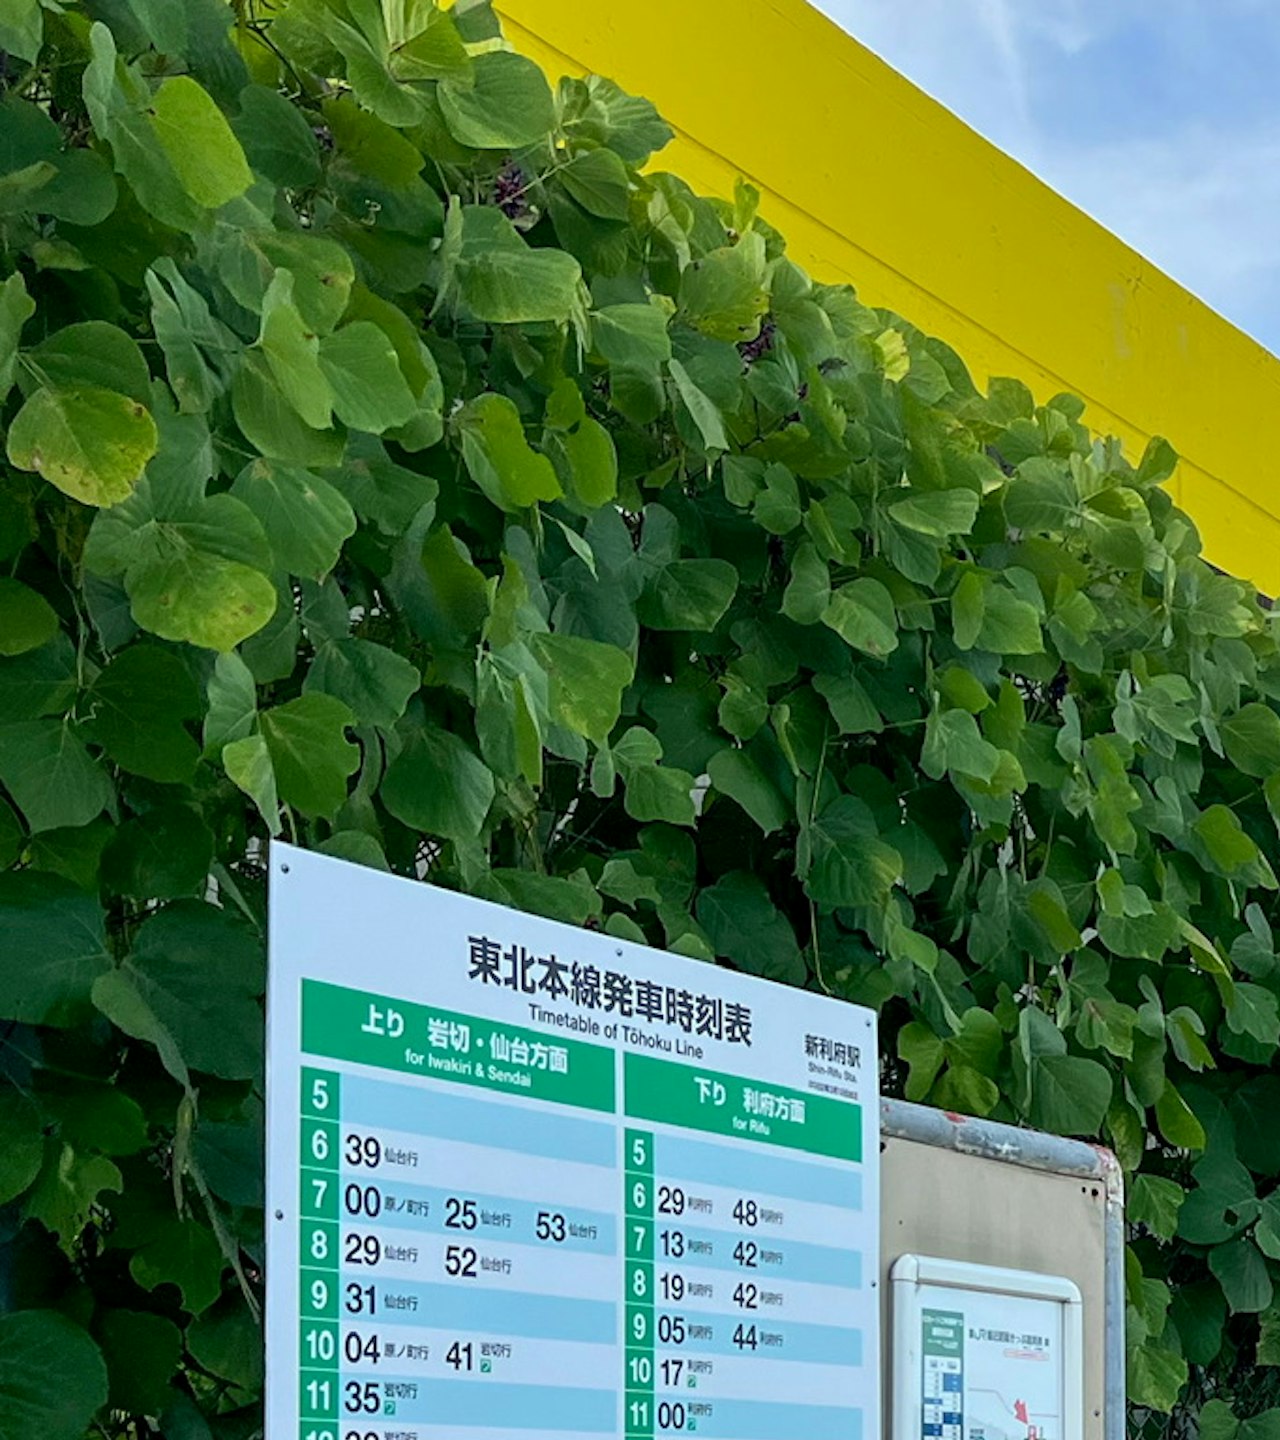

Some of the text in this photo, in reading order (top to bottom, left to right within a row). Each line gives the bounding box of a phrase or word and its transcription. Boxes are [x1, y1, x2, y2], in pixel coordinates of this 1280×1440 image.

[468, 934, 753, 1047] 東北本線発車時刻表
[361, 1004, 568, 1075] 上り 岩切・仙台方面
[528, 1004, 704, 1060] Timetable of Tōhoku Line
[804, 1033, 861, 1069] 新利府駅
[405, 1049, 532, 1088] for Iwakiri & Sendai
[313, 1079, 328, 1109] 5
[694, 1077, 727, 1107] 下り
[743, 1087, 806, 1124] 利府方面
[732, 1116, 770, 1137] for Rifu
[312, 1130, 418, 1168] 6 39 仙台行
[633, 1139, 645, 1165] 5
[312, 1179, 327, 1208] 7
[345, 1184, 380, 1217] 00
[445, 1198, 476, 1230] 25
[478, 1210, 511, 1228] 仙台行
[537, 1212, 565, 1241] 53
[566, 1223, 597, 1240] 仙台行
[633, 1183, 757, 1226] 6 29 48
[311, 1230, 511, 1277] 8 29 仙台行 52 仙台行
[634, 1226, 757, 1267] 7 13 42
[312, 1280, 418, 1314] 9 31 仙台行
[633, 1269, 757, 1309] 8 19 42
[306, 1330, 334, 1360] 10
[345, 1332, 380, 1364] 04
[446, 1342, 471, 1370] 41
[481, 1343, 511, 1360] 岩切行
[634, 1313, 757, 1350] 9 05 44
[630, 1357, 683, 1385] 10 17
[307, 1380, 417, 1413] 11 35 岩切行
[630, 1402, 684, 1429] 11 00
